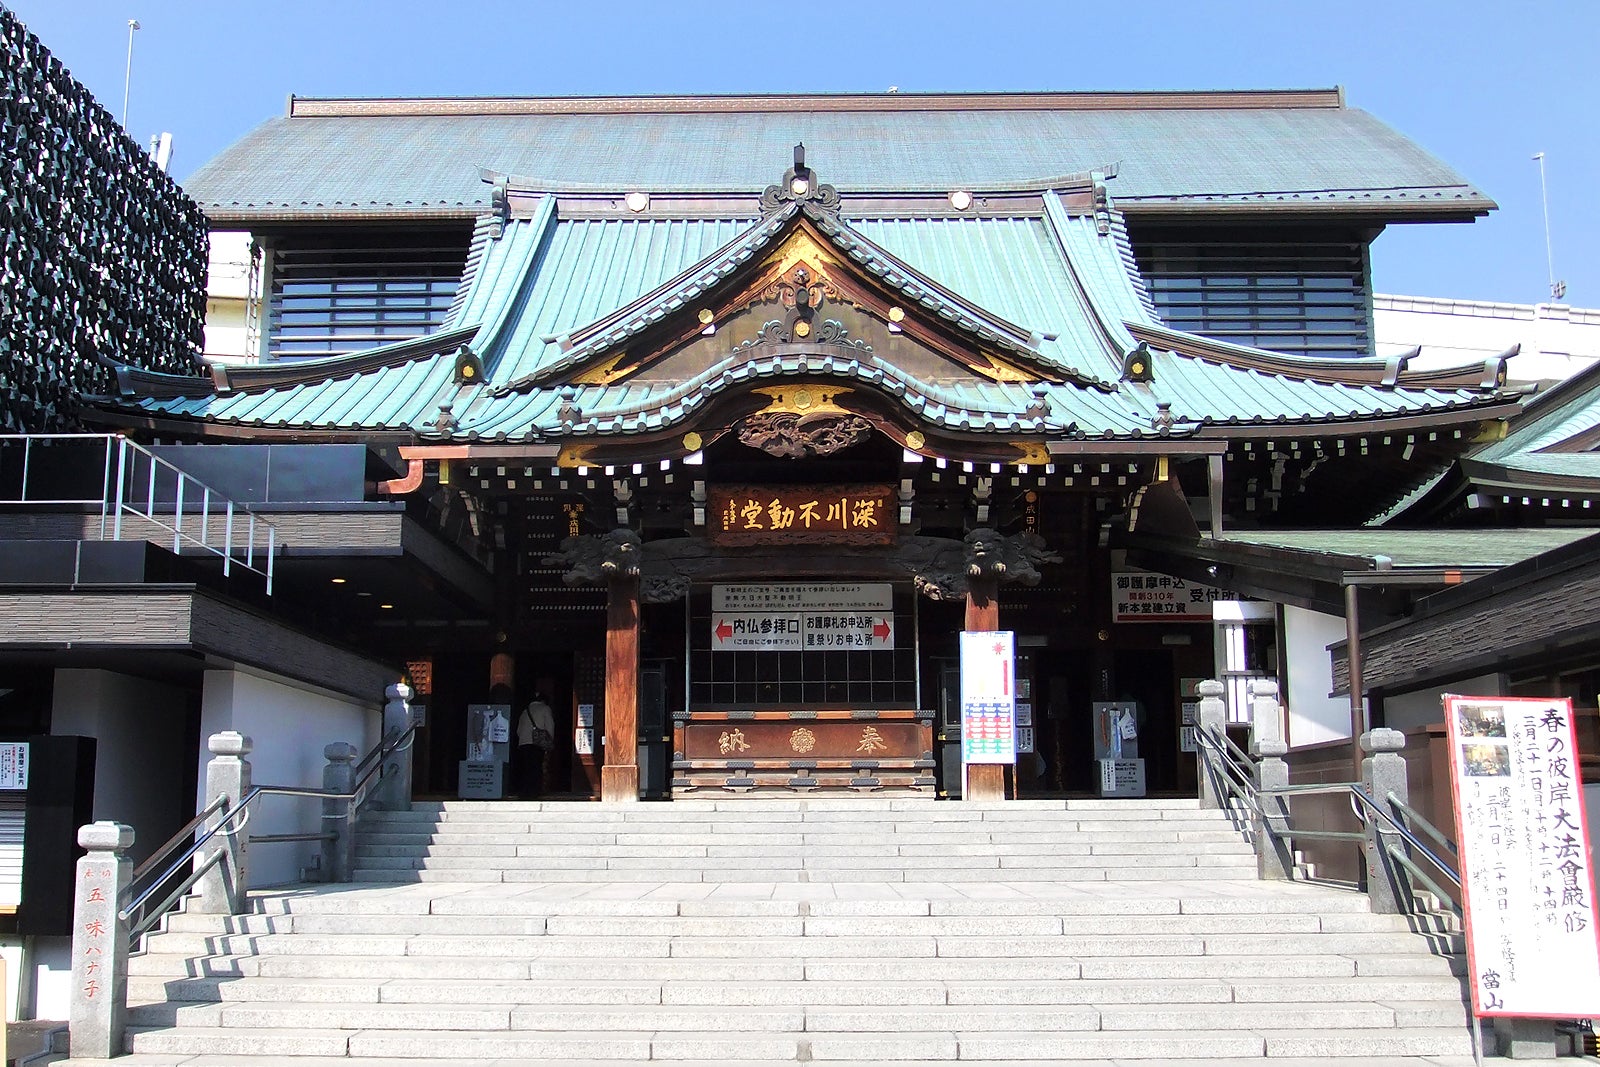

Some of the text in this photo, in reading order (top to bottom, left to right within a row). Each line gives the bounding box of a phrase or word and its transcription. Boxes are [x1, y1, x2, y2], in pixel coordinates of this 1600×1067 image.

[740, 497, 878, 530] 深川不動堂
[1117, 576, 1185, 589] 御護摩申込
[1128, 591, 1174, 601] 開創310年
[733, 619, 799, 634] 内仏参拝口
[806, 616, 873, 629] お護摩札お申込所
[806, 633, 873, 646] 星祭りお申込所
